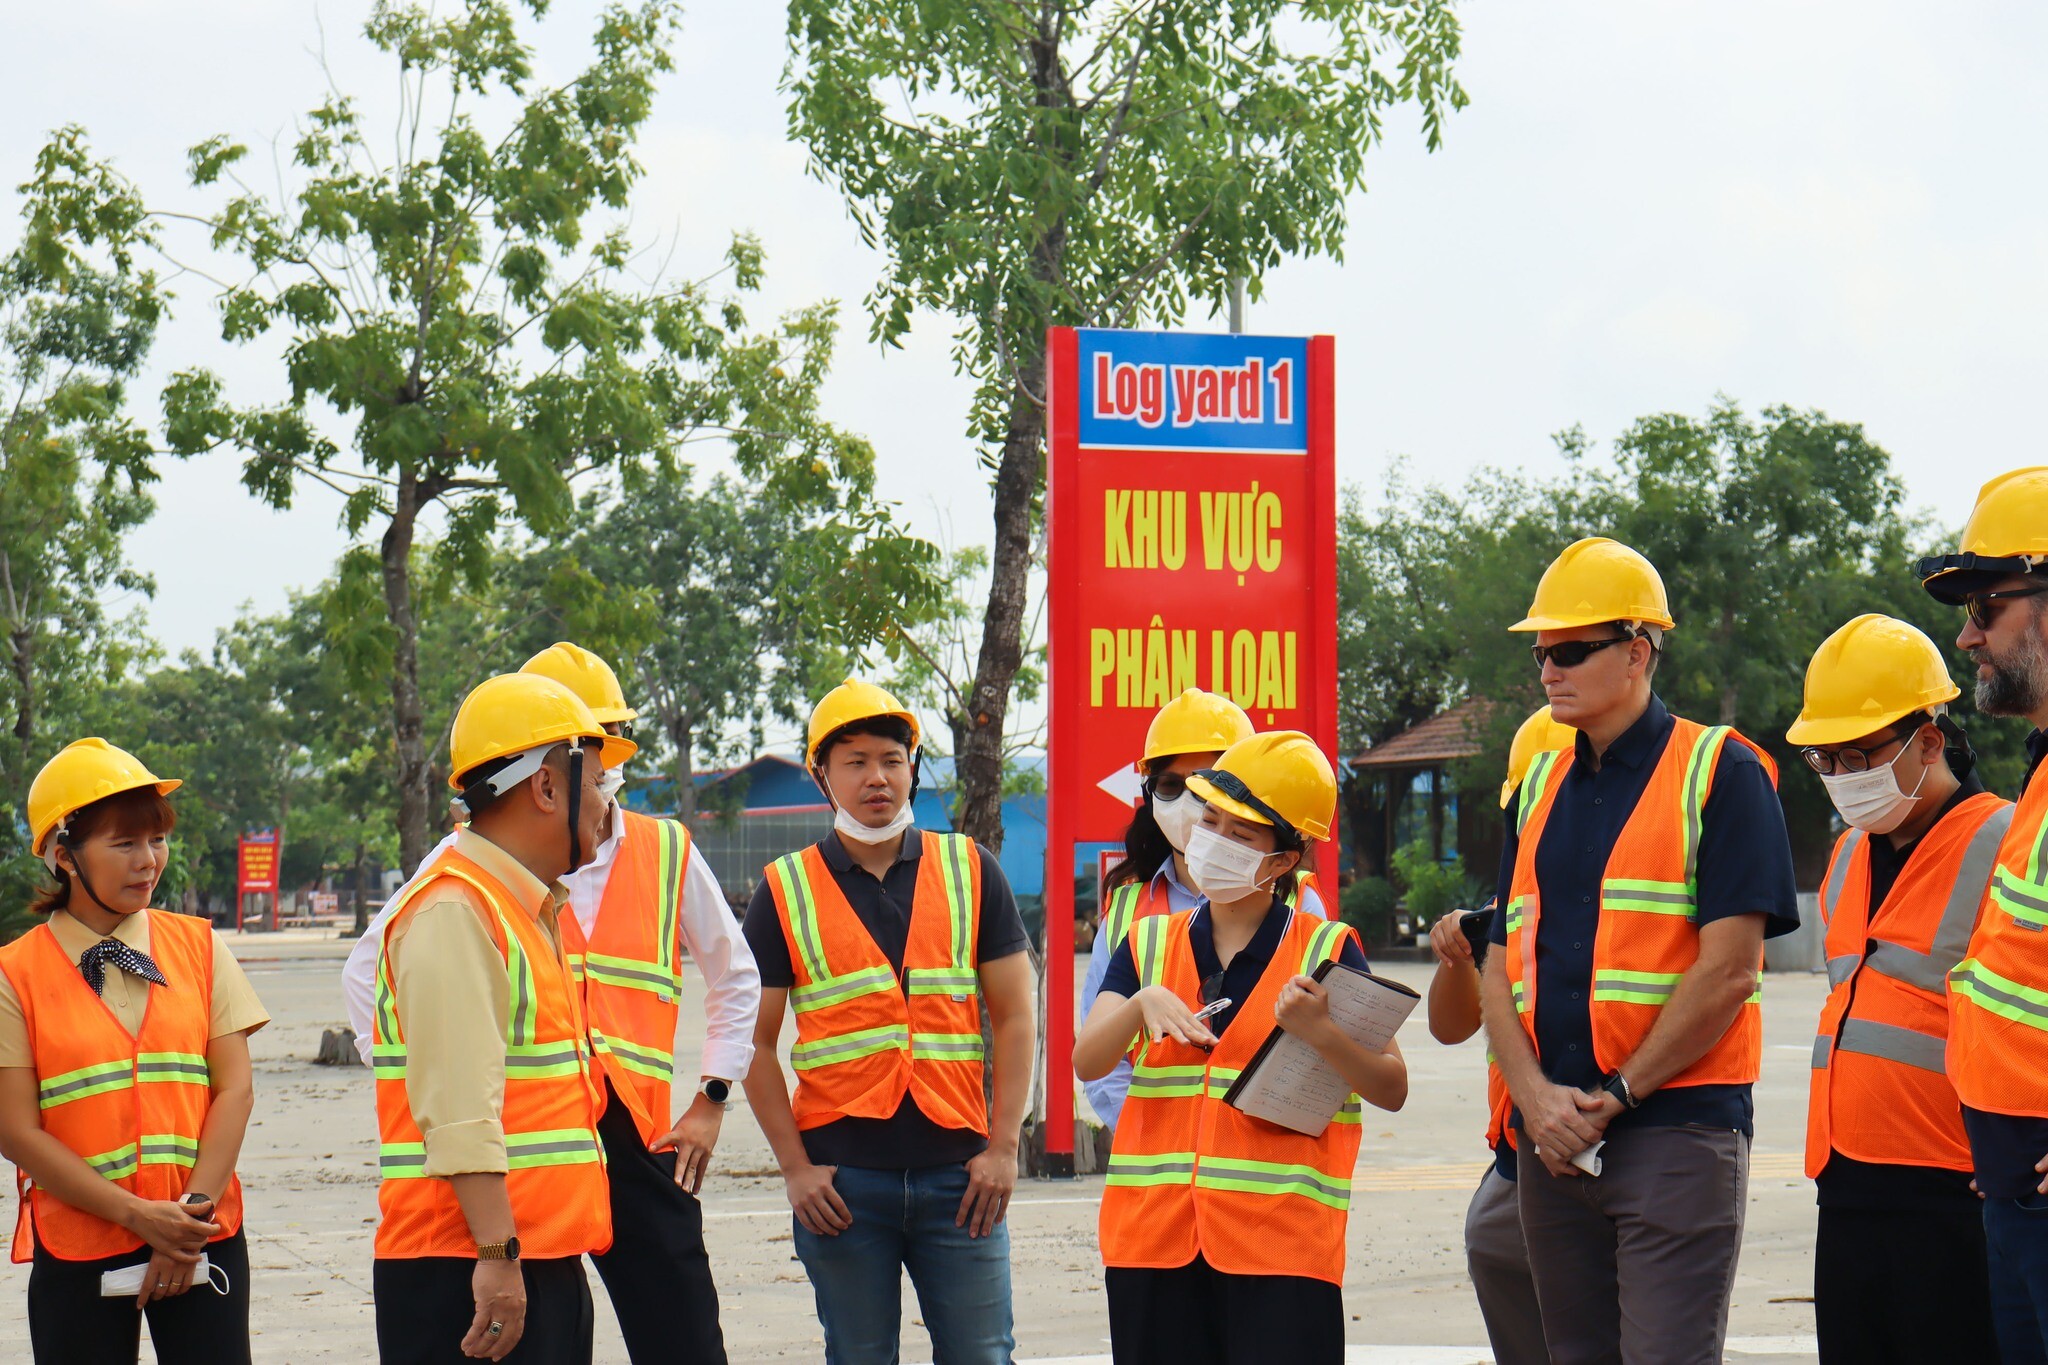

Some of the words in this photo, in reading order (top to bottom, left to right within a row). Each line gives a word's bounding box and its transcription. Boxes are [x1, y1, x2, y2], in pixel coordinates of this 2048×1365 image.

[1095, 353, 1164, 426] Log
[1172, 359, 1261, 425] yard
[1270, 360, 1291, 421] 1
[1105, 489, 1187, 571] KHU
[1200, 481, 1281, 586] VỰC
[1091, 614, 1197, 708] PHÂN
[1212, 629, 1296, 725] LOẠI
